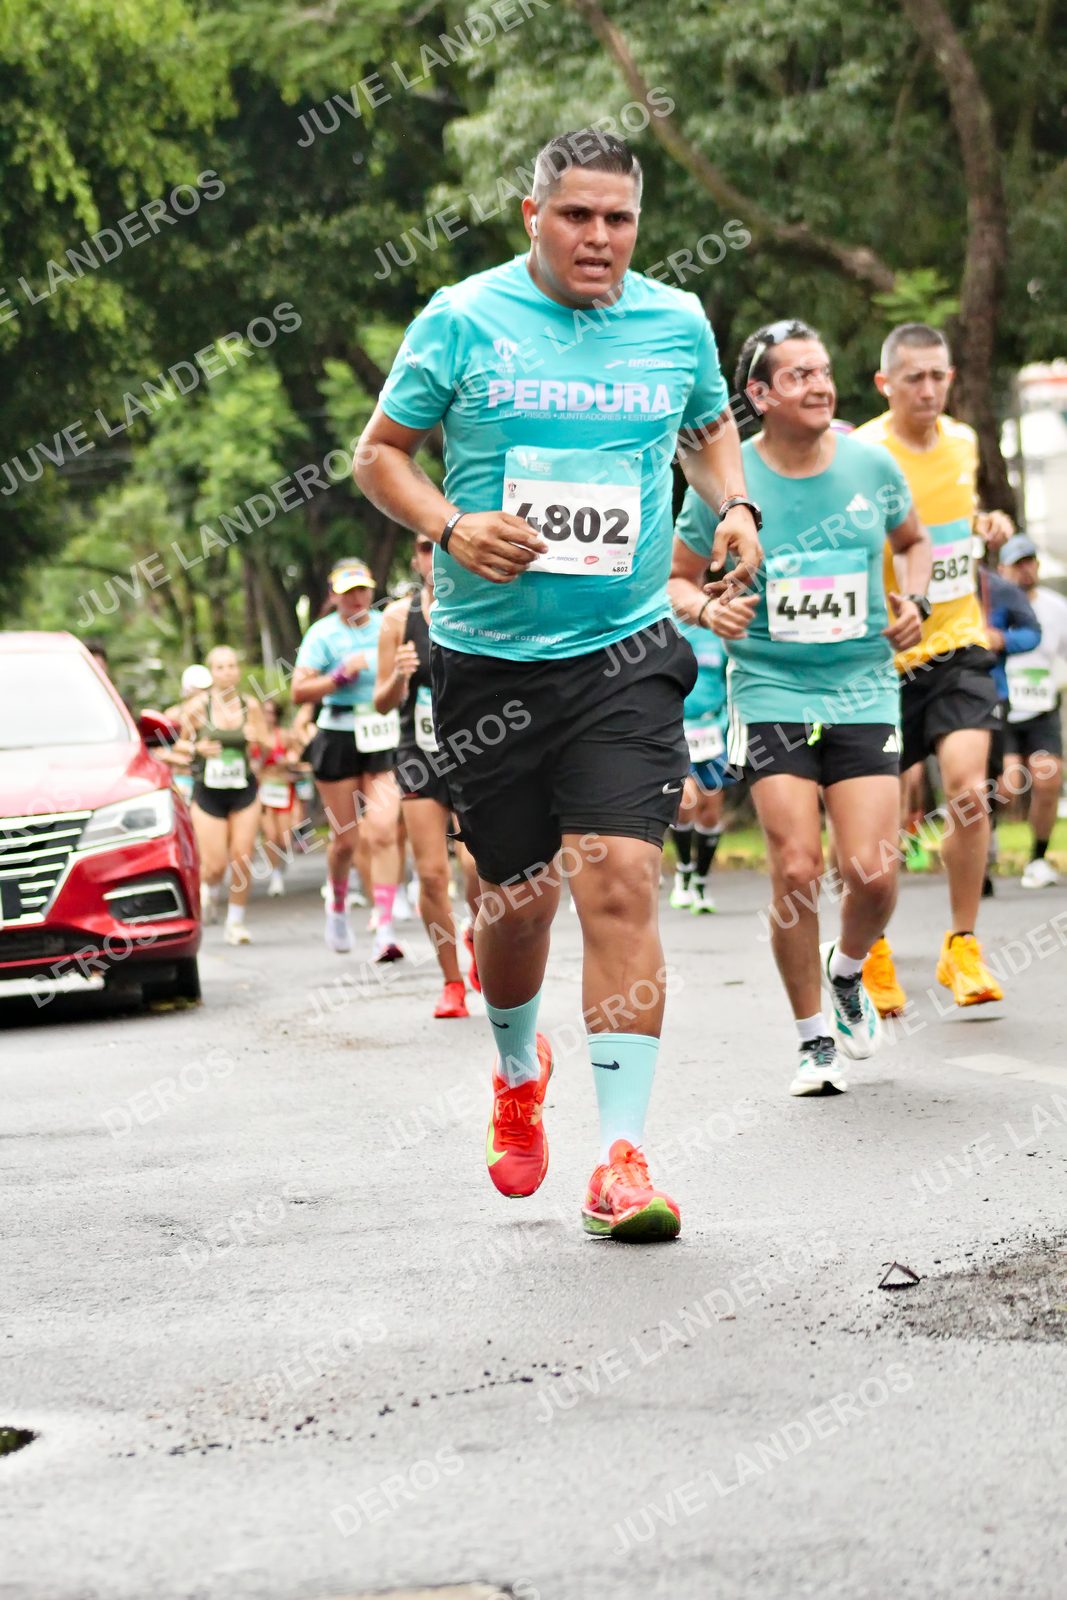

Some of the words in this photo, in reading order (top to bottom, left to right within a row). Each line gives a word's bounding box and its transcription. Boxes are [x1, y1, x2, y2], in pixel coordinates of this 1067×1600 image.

[487, 379, 674, 413] PERDURA
[515, 502, 630, 545] 4802
[776, 591, 856, 621] 4441
